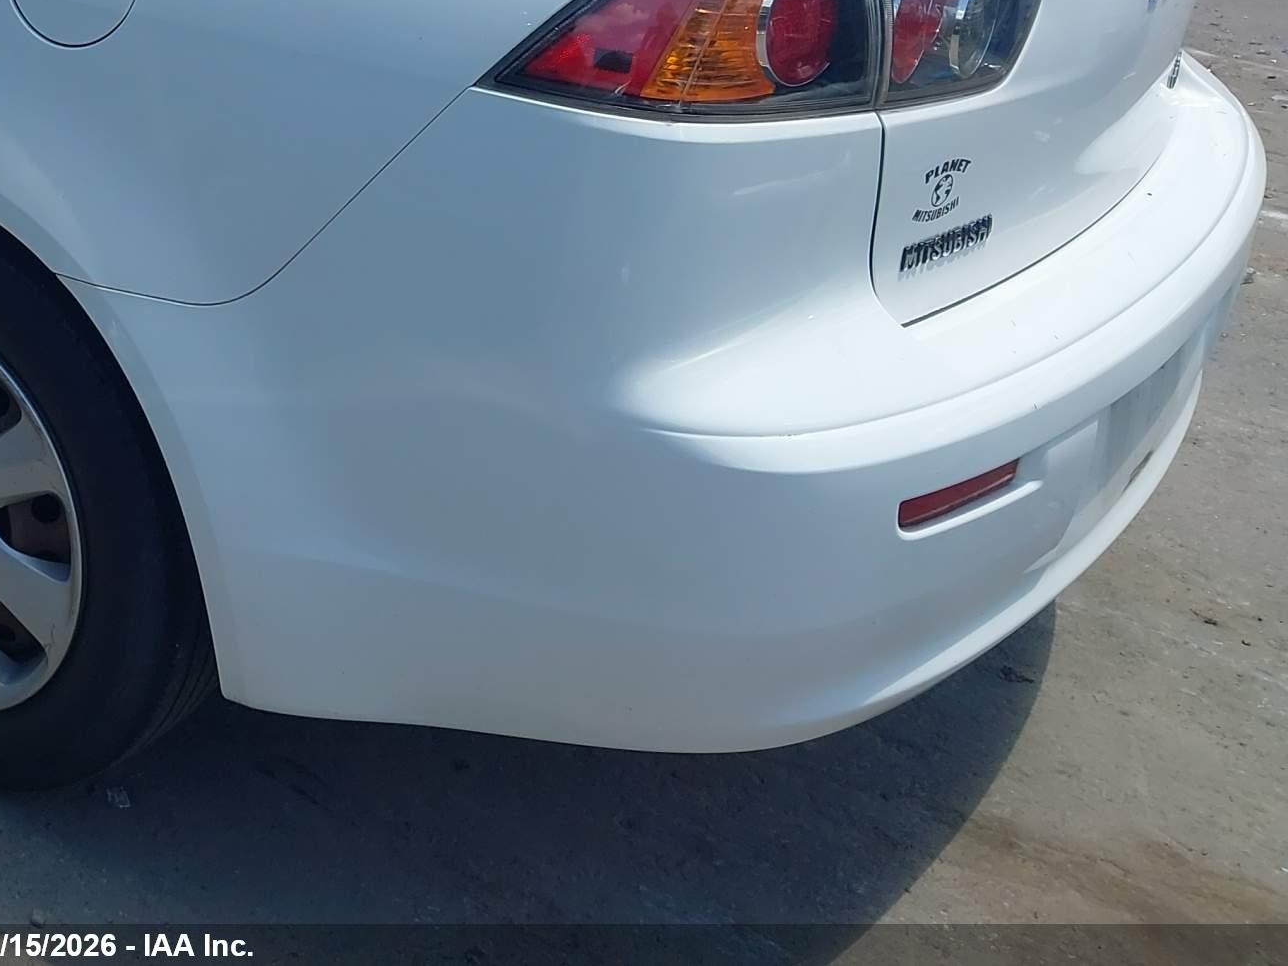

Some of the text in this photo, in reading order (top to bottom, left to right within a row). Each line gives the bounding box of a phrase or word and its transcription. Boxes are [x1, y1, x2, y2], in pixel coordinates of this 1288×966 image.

[925, 158, 971, 184] PLANET
[912, 196, 959, 222] MITSUBISHI
[900, 214, 992, 272] MITSUBISHI
